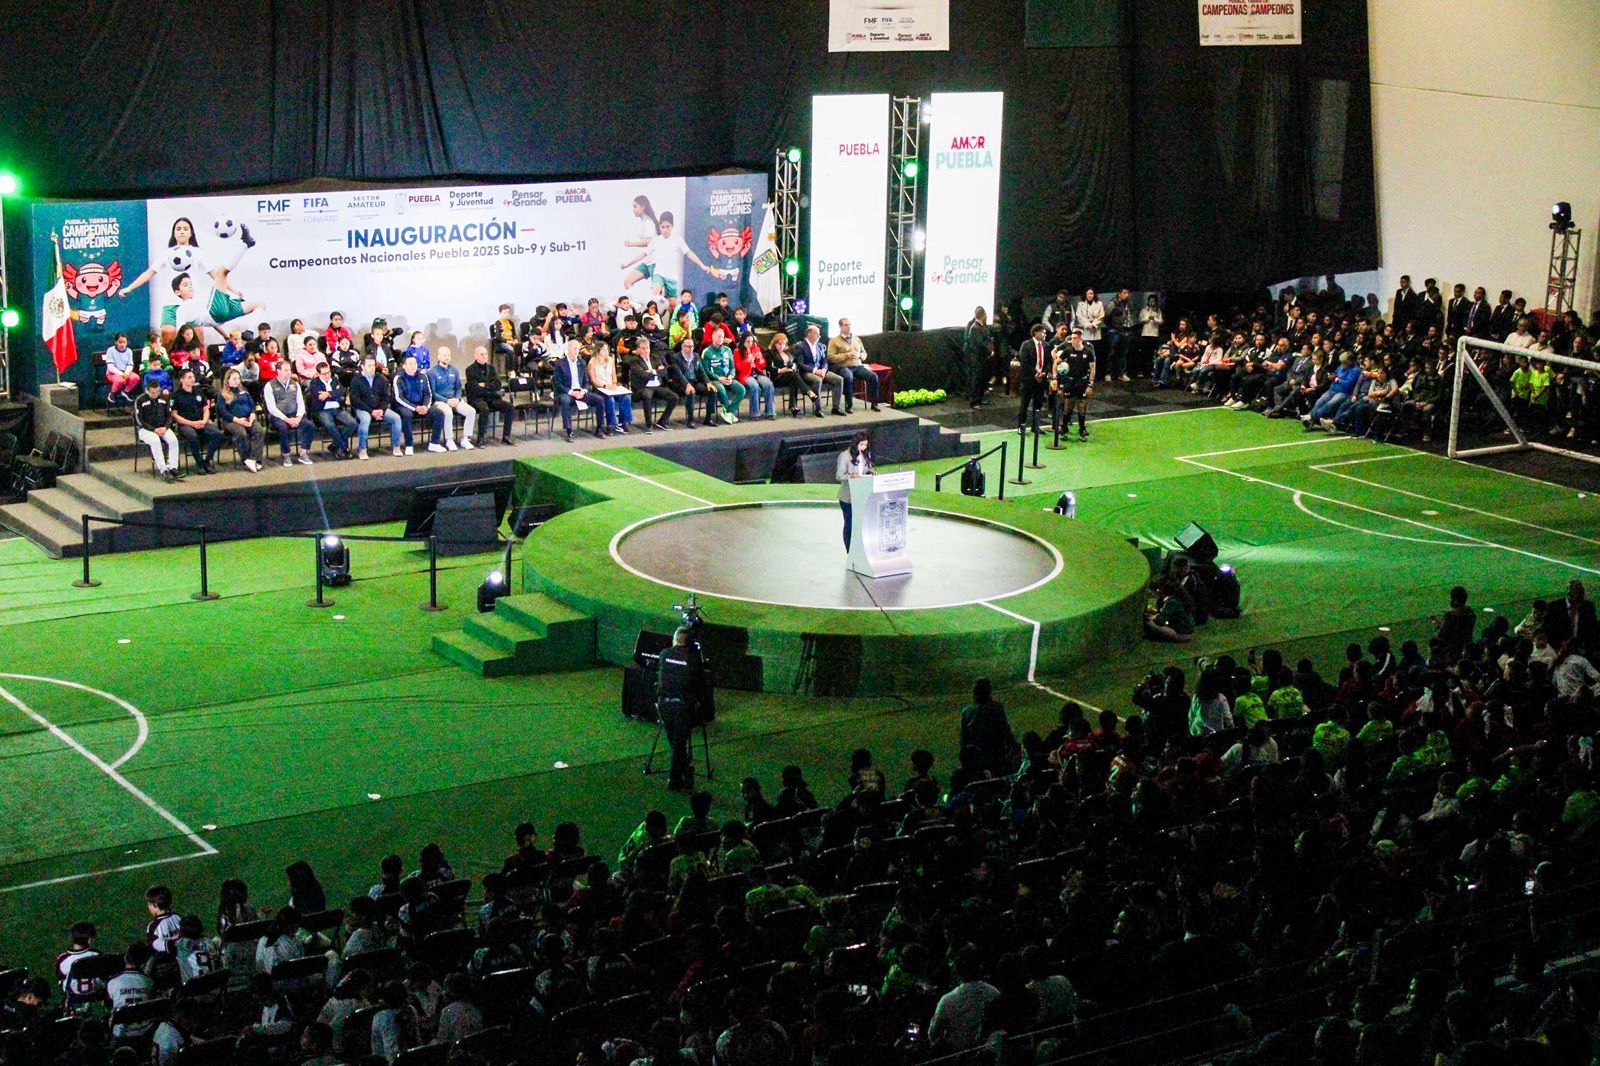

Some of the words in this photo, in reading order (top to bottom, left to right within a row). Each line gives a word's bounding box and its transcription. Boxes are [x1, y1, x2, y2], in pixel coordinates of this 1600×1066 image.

[1202, 4, 1247, 15] CAMPEONAS
[1251, 4, 1294, 15] CAMPEONES
[839, 142, 880, 156] PUEBLA
[935, 151, 993, 169] PUEBLA
[408, 194, 441, 203] PUEBLA
[449, 190, 483, 200] Deporte
[512, 190, 544, 200] Pensar
[555, 194, 592, 204] PUEBLA
[710, 193, 752, 205] CAMPEONAS
[257, 199, 291, 213] FMF
[303, 197, 329, 208] FIFA
[347, 201, 386, 209] AMATEUR
[456, 197, 494, 206] Juventud
[513, 198, 548, 207] Grande
[710, 204, 752, 216] CAMPEONES
[62, 223, 120, 237] CAMPEONAS
[347, 217, 517, 249] INAUGURACIÓN
[62, 236, 120, 250] CAMPEONES
[269, 255, 357, 270] Campeonatos
[360, 250, 426, 264] Nacionales
[429, 246, 470, 259] Puebla
[472, 245, 500, 257] 2025
[503, 243, 537, 255] Sub-9
[540, 246, 546, 255] y
[549, 240, 586, 253] Sub-11
[818, 260, 862, 273] Deporte
[943, 255, 984, 269] Pensar
[818, 278, 823, 290] y
[827, 272, 875, 286] Juventud
[944, 268, 988, 285] Grande
